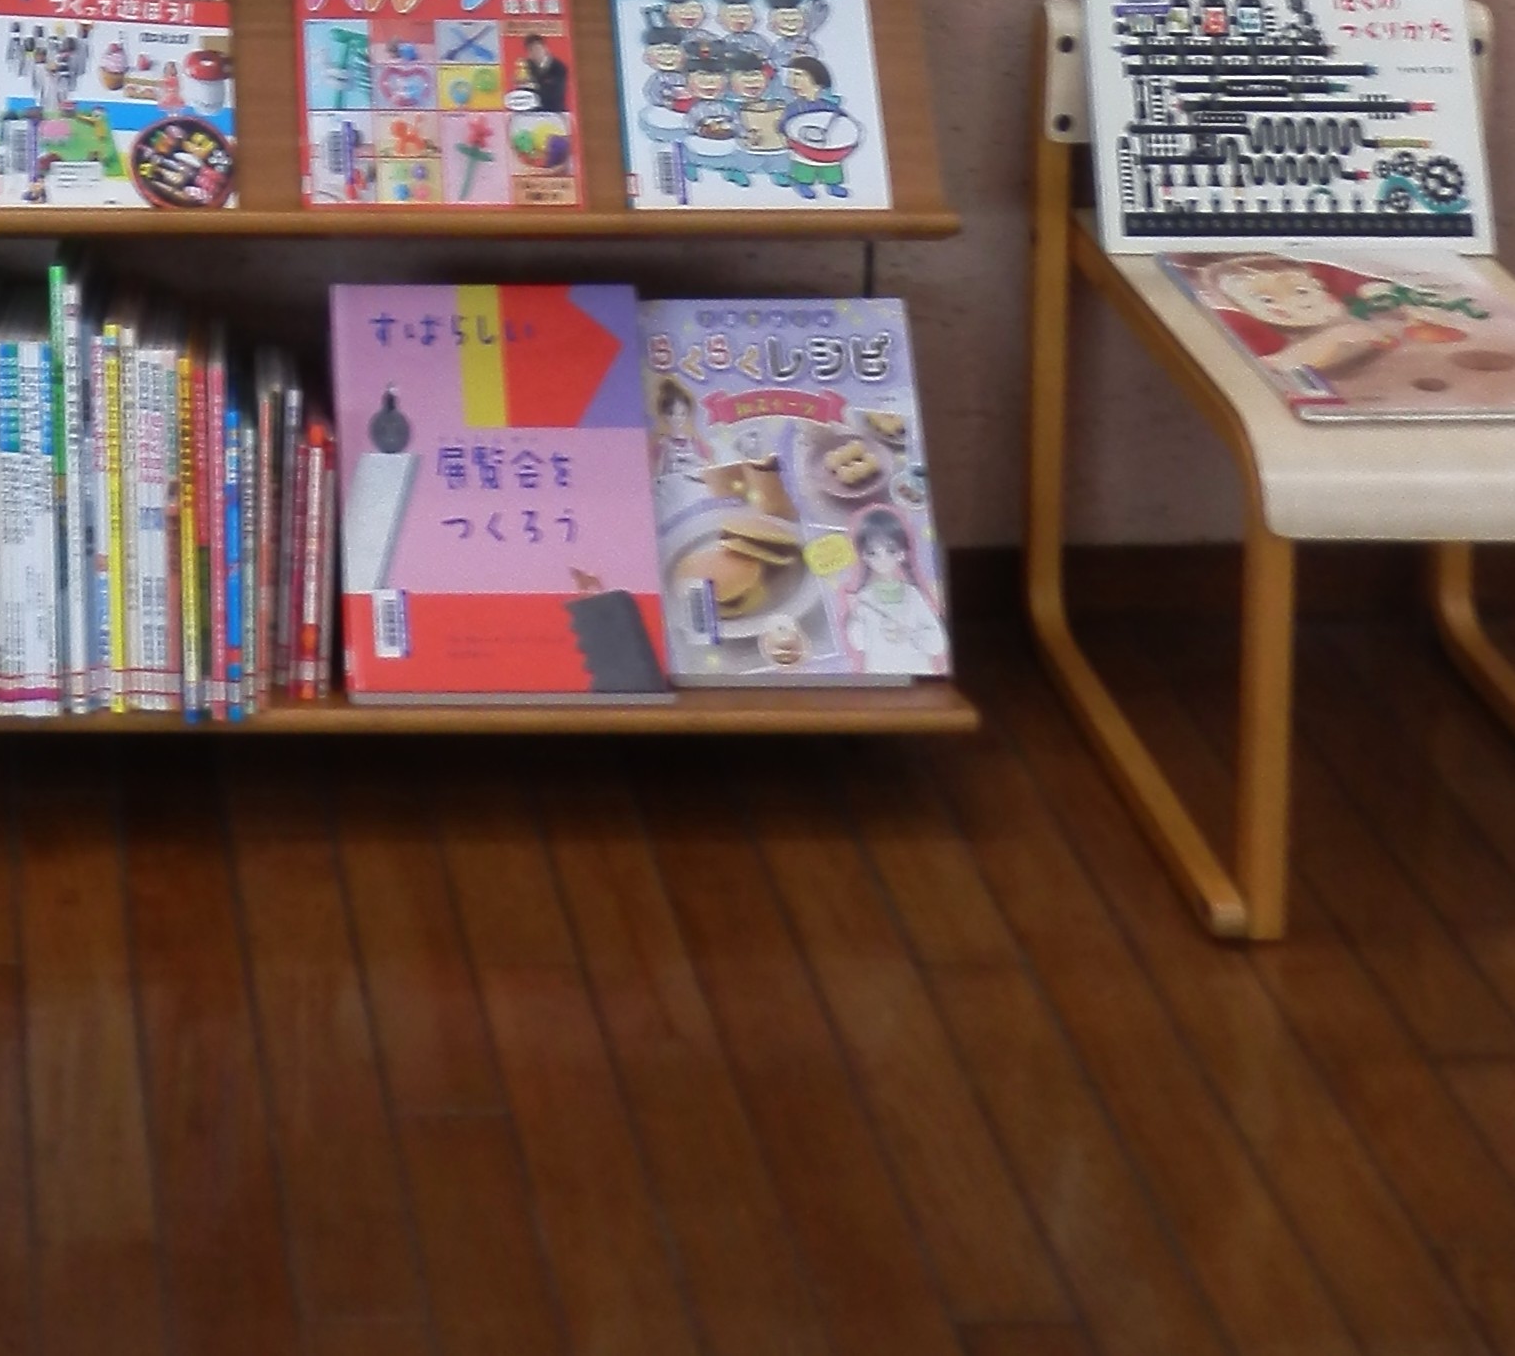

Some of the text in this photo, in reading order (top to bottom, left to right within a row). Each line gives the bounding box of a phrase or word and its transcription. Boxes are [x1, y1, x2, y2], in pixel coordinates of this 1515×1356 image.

[1337, 18, 1454, 43] つくりかた
[649, 331, 892, 381] らくらくレシピ
[437, 445, 572, 491] 展覧会を
[441, 508, 580, 544] つくろう
